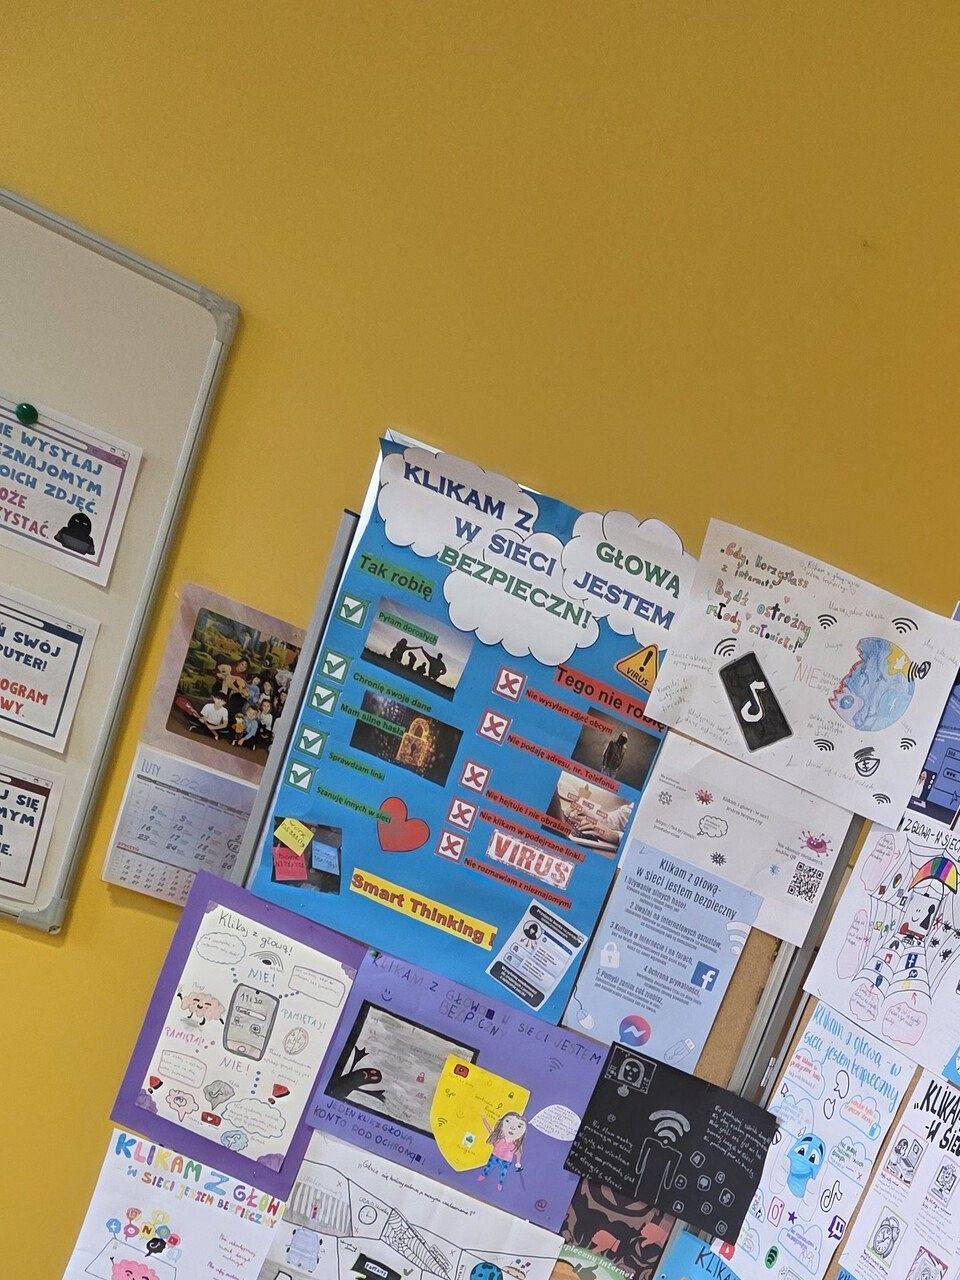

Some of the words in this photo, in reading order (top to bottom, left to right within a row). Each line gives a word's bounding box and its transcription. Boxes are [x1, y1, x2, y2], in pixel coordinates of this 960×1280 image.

[404, 462, 505, 520] KLIKAM
[514, 508, 535, 532] Z
[596, 541, 681, 599] GŁOWĄ
[358, 555, 388, 580] Tak
[396, 572, 434, 601] robię
[454, 516, 482, 544] W
[488, 533, 557, 577] SIECI
[572, 570, 676, 631] JESTEM
[706, 602, 742, 634] młody
[715, 578, 749, 606] Bądź
[757, 602, 811, 643] ostrożny
[13, 630, 61, 658] SWÓJ
[353, 673, 384, 693] Chronię
[411, 698, 432, 712] dane
[557, 668, 595, 696] Tego
[598, 688, 623, 709] nie
[626, 667, 649, 686] VIRUS
[340, 703, 361, 718] Mam
[362, 713, 382, 725] silne
[526, 690, 537, 700] Nie
[539, 695, 569, 715] wysyłam
[589, 719, 613, 734] obcym
[508, 735, 520, 747] Nie
[141, 758, 161, 777] LUTY
[328, 752, 369, 774] Sprawdzam
[370, 769, 385, 781] linki
[15, 794, 40, 812] SIĘ
[487, 790, 498, 802] Nie
[528, 809, 540, 820] nie
[479, 811, 491, 822] Nie
[492, 815, 516, 833] klikam
[525, 830, 565, 853] podejrzane
[465, 858, 477, 870] Nie
[478, 862, 518, 887] rozmawiam
[493, 834, 570, 884] VIRUS
[658, 858, 687, 879] Klikam
[687, 872, 693, 882] z
[636, 866, 644, 877] w
[645, 870, 665, 886] sieci
[664, 879, 692, 899] jestem
[693, 892, 737, 920] bezpieczny
[352, 873, 405, 908] Smart
[410, 898, 485, 946] Thinking
[218, 911, 250, 938] Klikaj
[259, 935, 294, 956] głową!
[313, 1107, 347, 1129] KONTO
[114, 1132, 202, 1183] KLIKAM
[204, 1170, 227, 1196] Z
[141, 1172, 176, 1193] SIECI
[599, 1259, 634, 1280] internet
